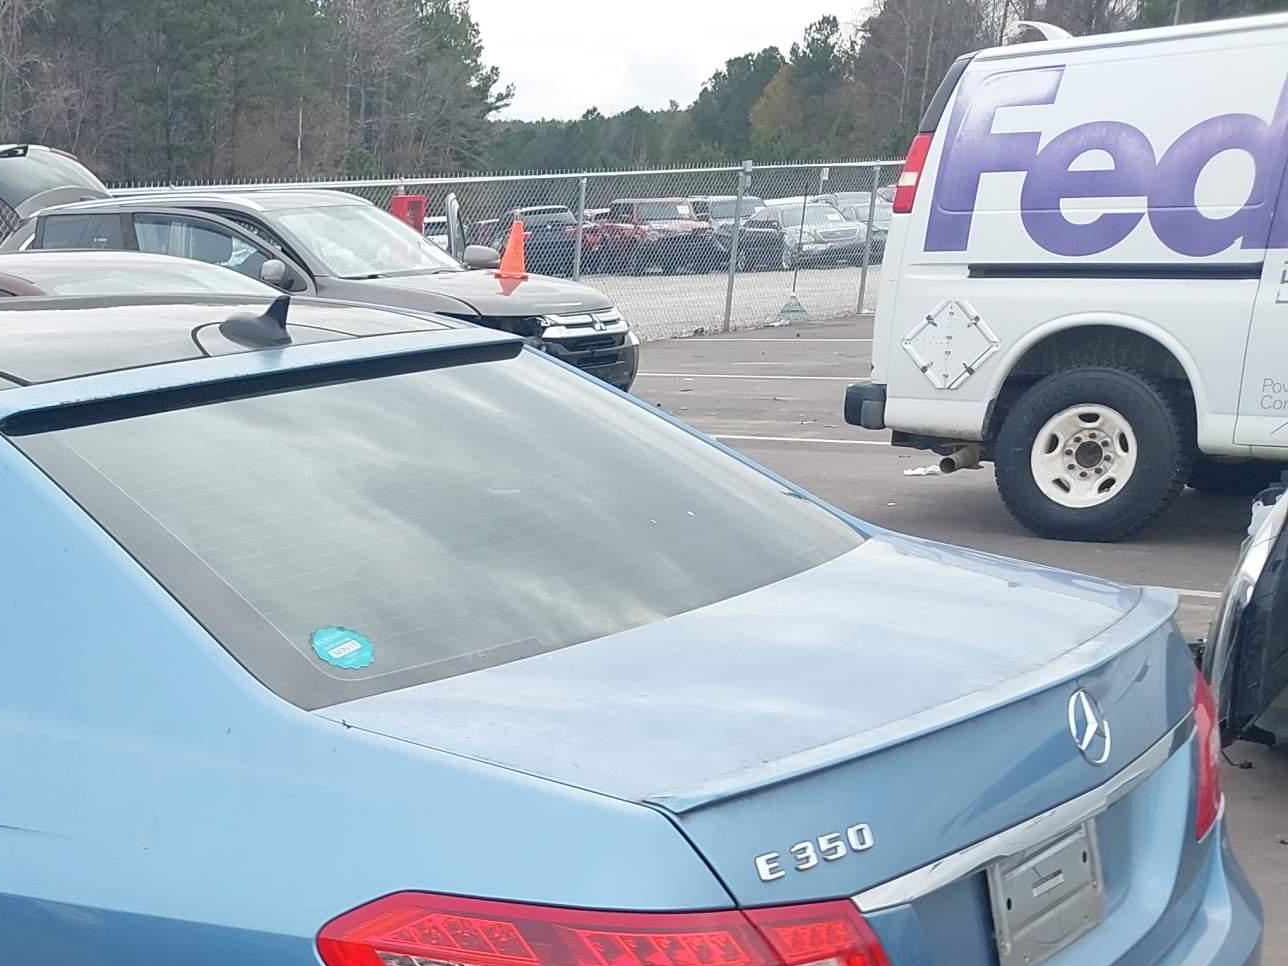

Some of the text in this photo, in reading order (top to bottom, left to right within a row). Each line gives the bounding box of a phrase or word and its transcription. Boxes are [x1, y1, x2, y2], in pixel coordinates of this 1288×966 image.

[923, 65, 1288, 257] Fed
[755, 823, 874, 882] E 350
